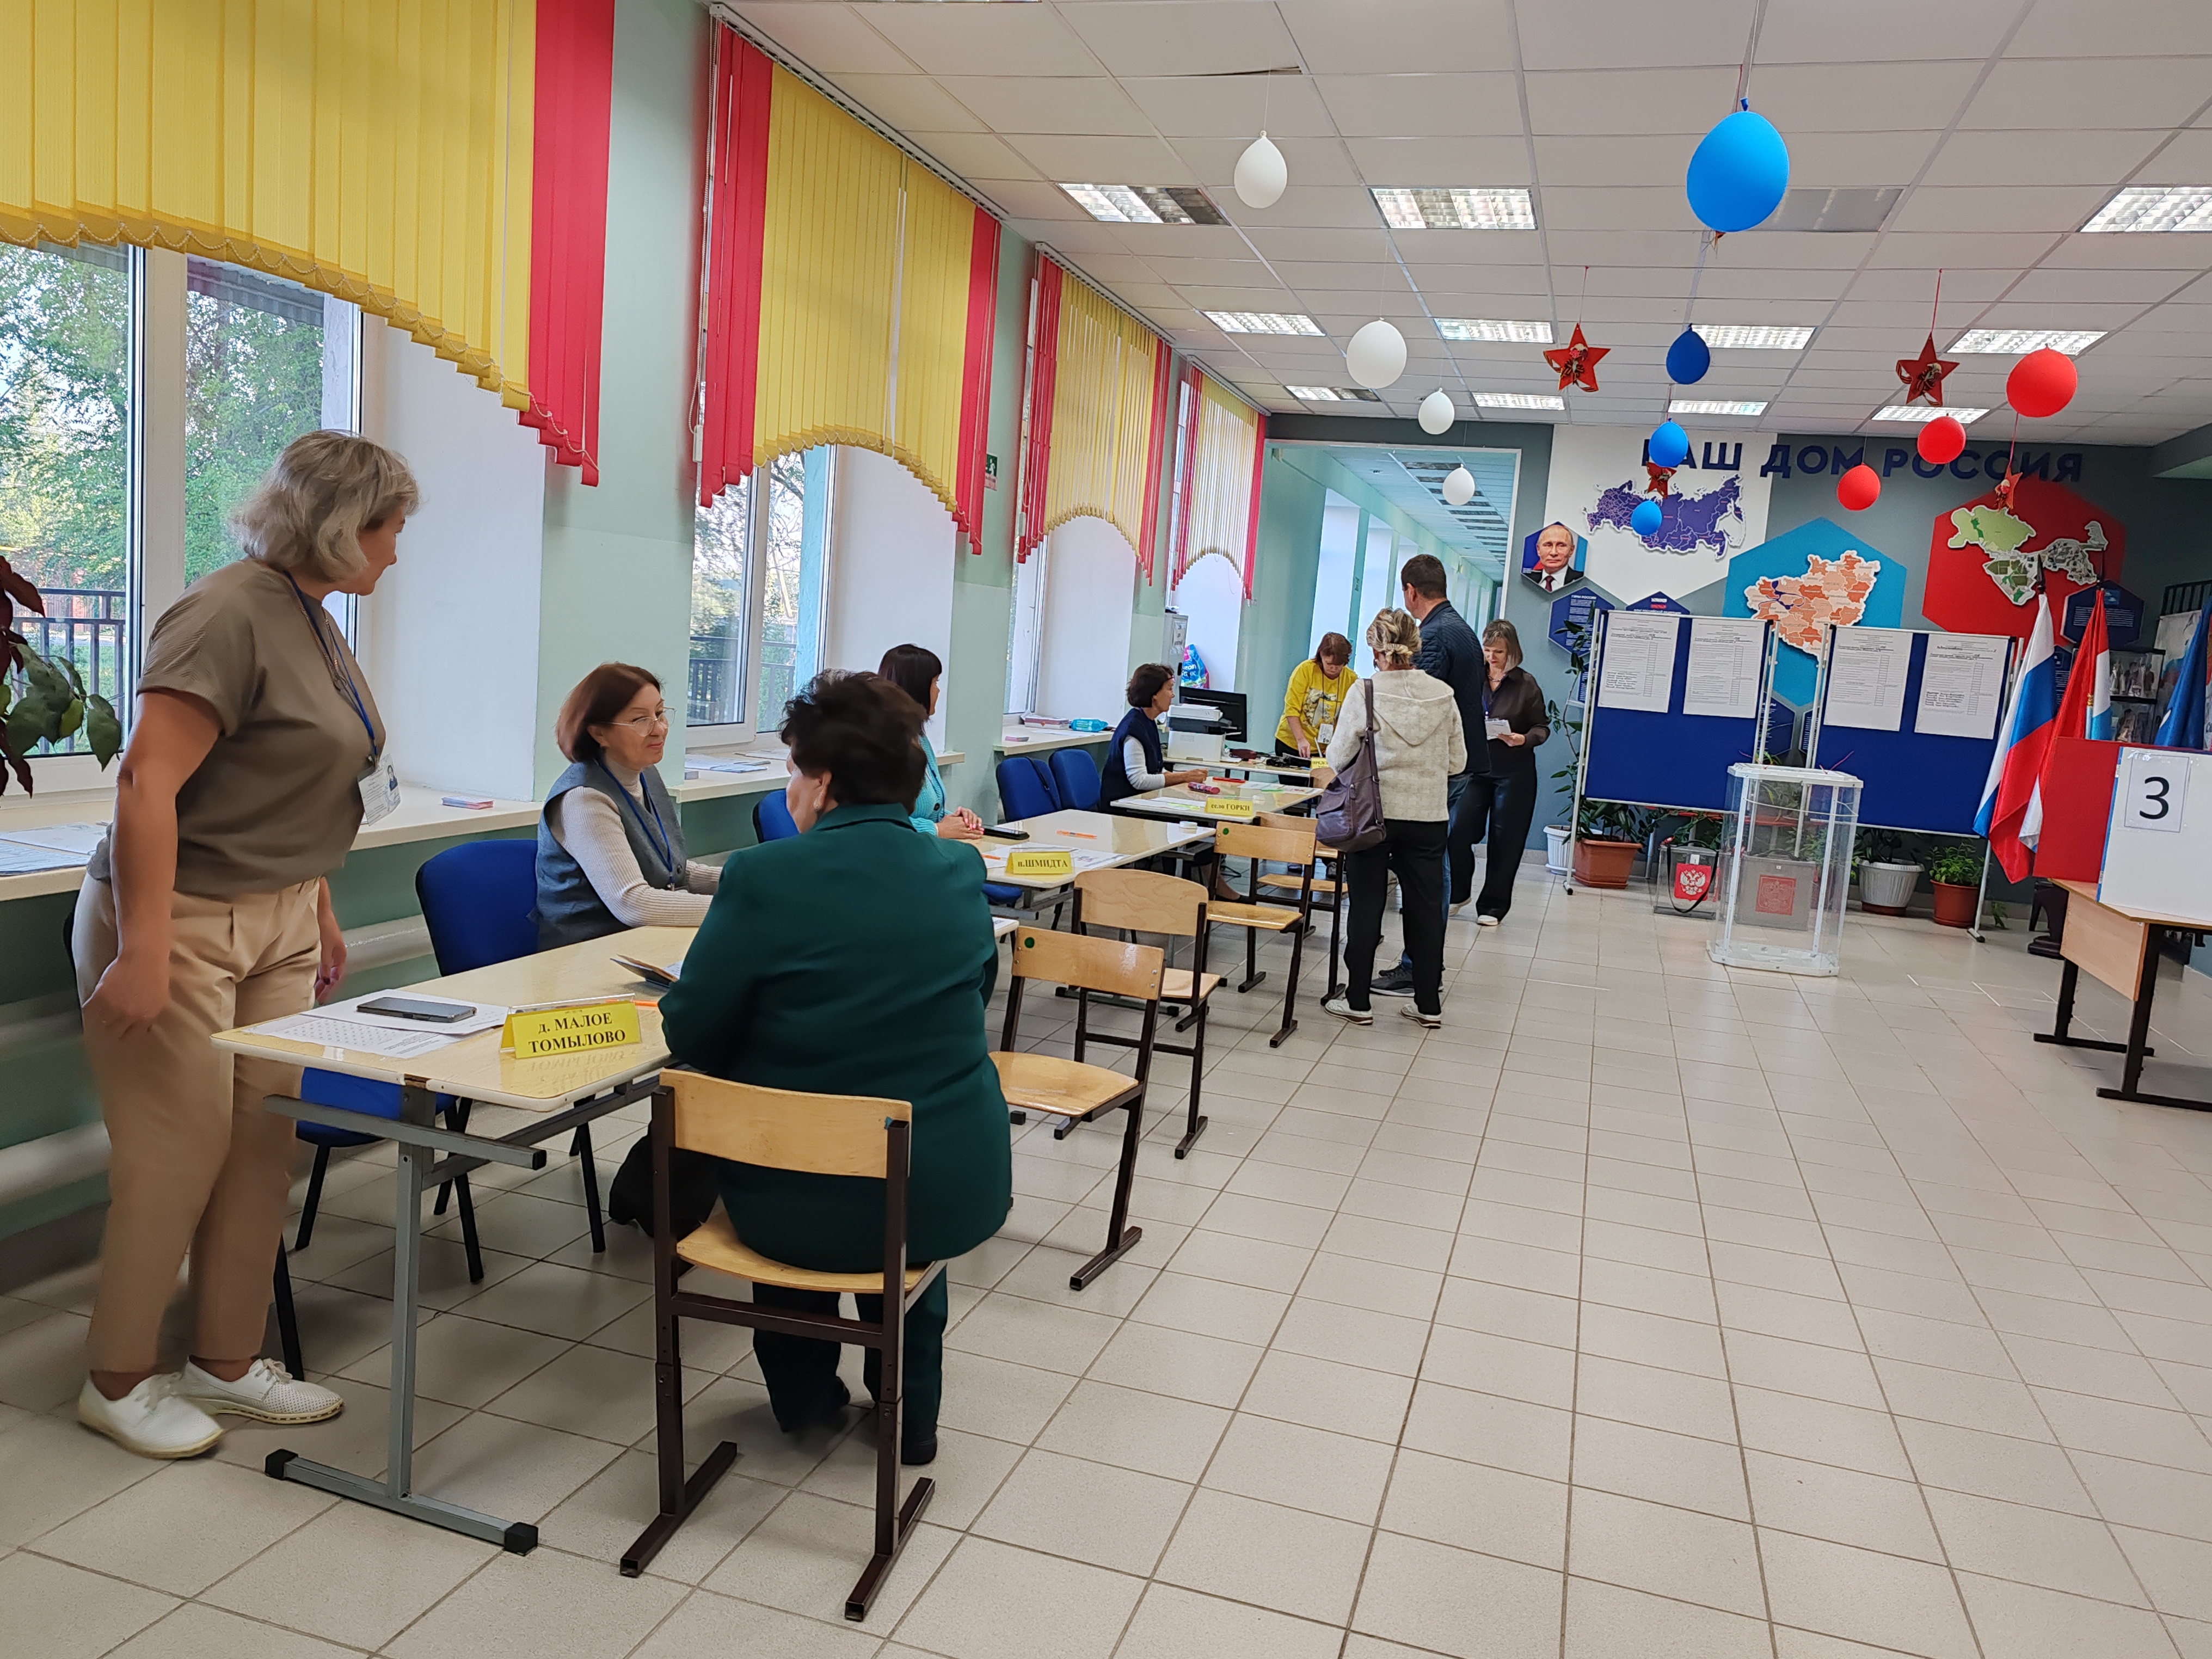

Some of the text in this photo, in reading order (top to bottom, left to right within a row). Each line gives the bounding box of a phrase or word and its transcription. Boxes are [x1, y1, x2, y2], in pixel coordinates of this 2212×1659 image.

[1760, 444, 1864, 478] ДОМ
[1883, 448, 2083, 482] РОССИЯ
[1226, 803, 1251, 812] ГОРКИ
[2139, 776, 2170, 820] 3
[1018, 859, 1068, 869] п.ШМИДТА
[538, 1012, 613, 1034] д. МАЛОЕ
[528, 1029, 626, 1053] ТОМЫЛОВО
